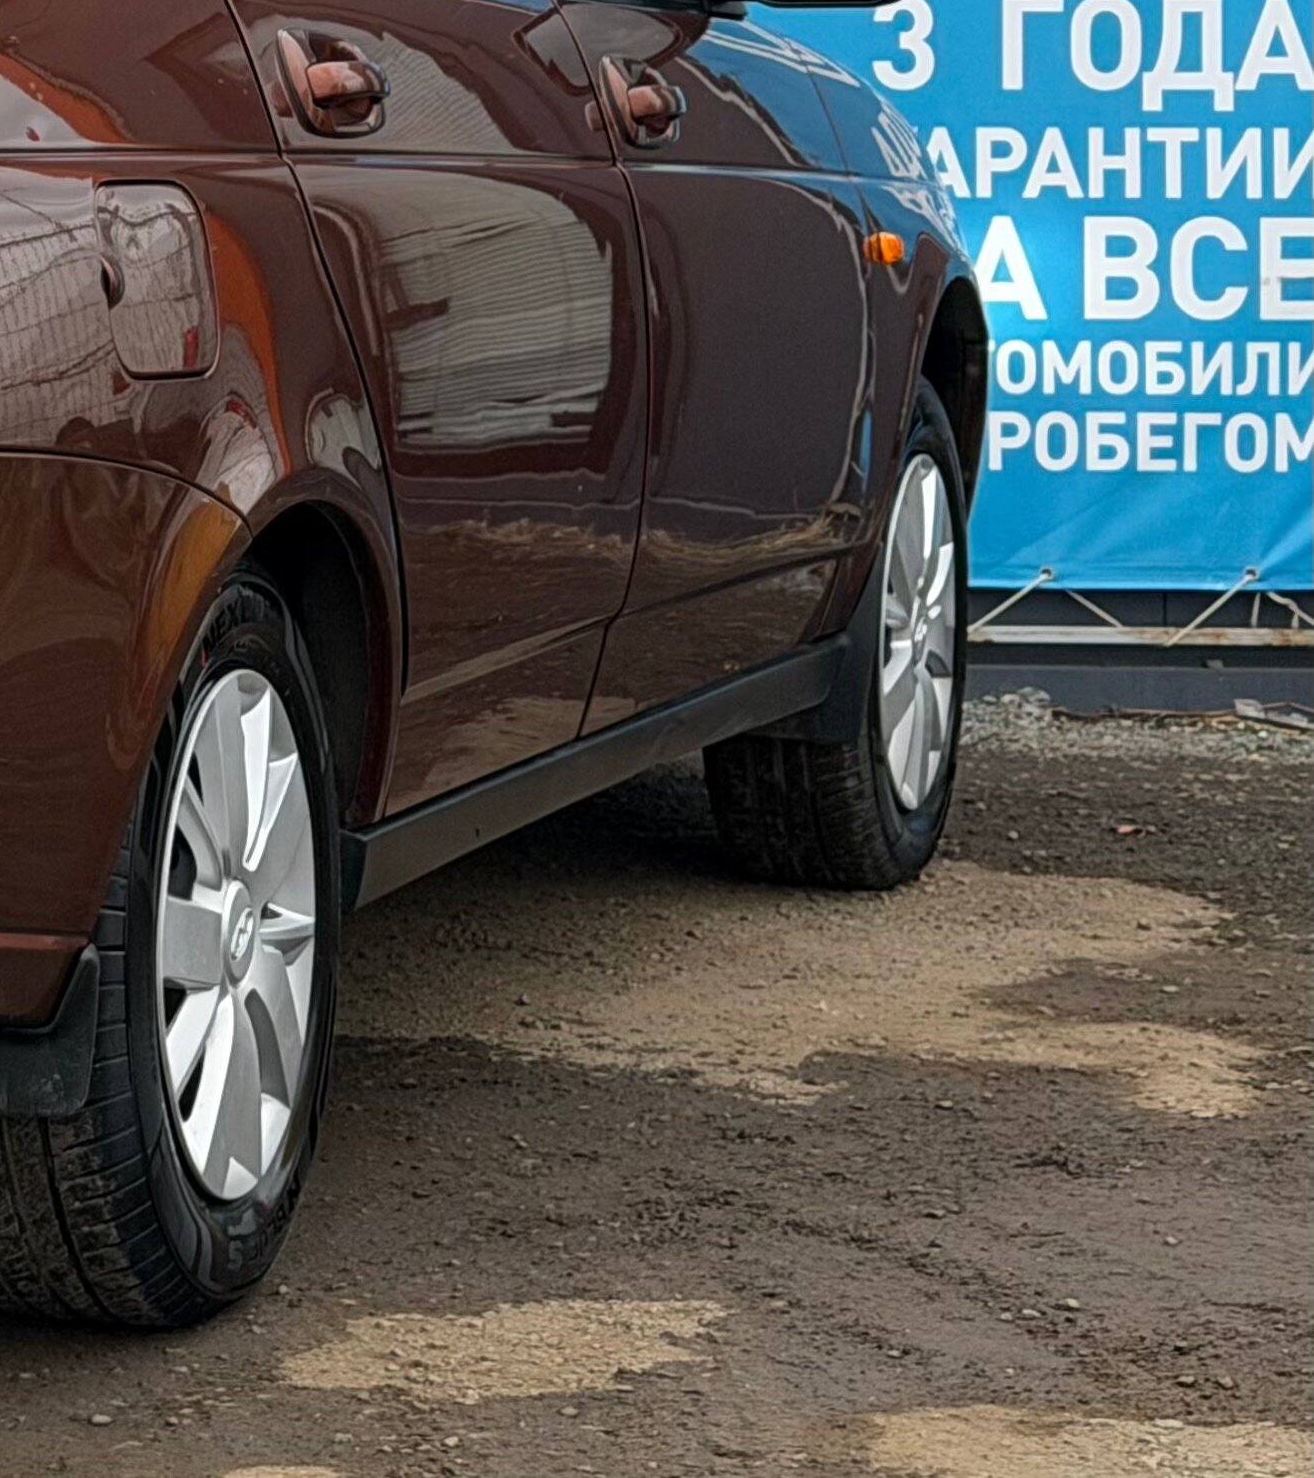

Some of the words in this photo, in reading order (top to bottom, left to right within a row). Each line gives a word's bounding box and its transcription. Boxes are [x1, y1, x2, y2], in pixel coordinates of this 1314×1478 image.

[923, 126, 1314, 199] АРАНТИИ
[1083, 216, 1314, 321] ВСЕ
[989, 339, 1314, 396] ОМОБИЛИ
[987, 411, 1314, 473] РОБЕГОМ
